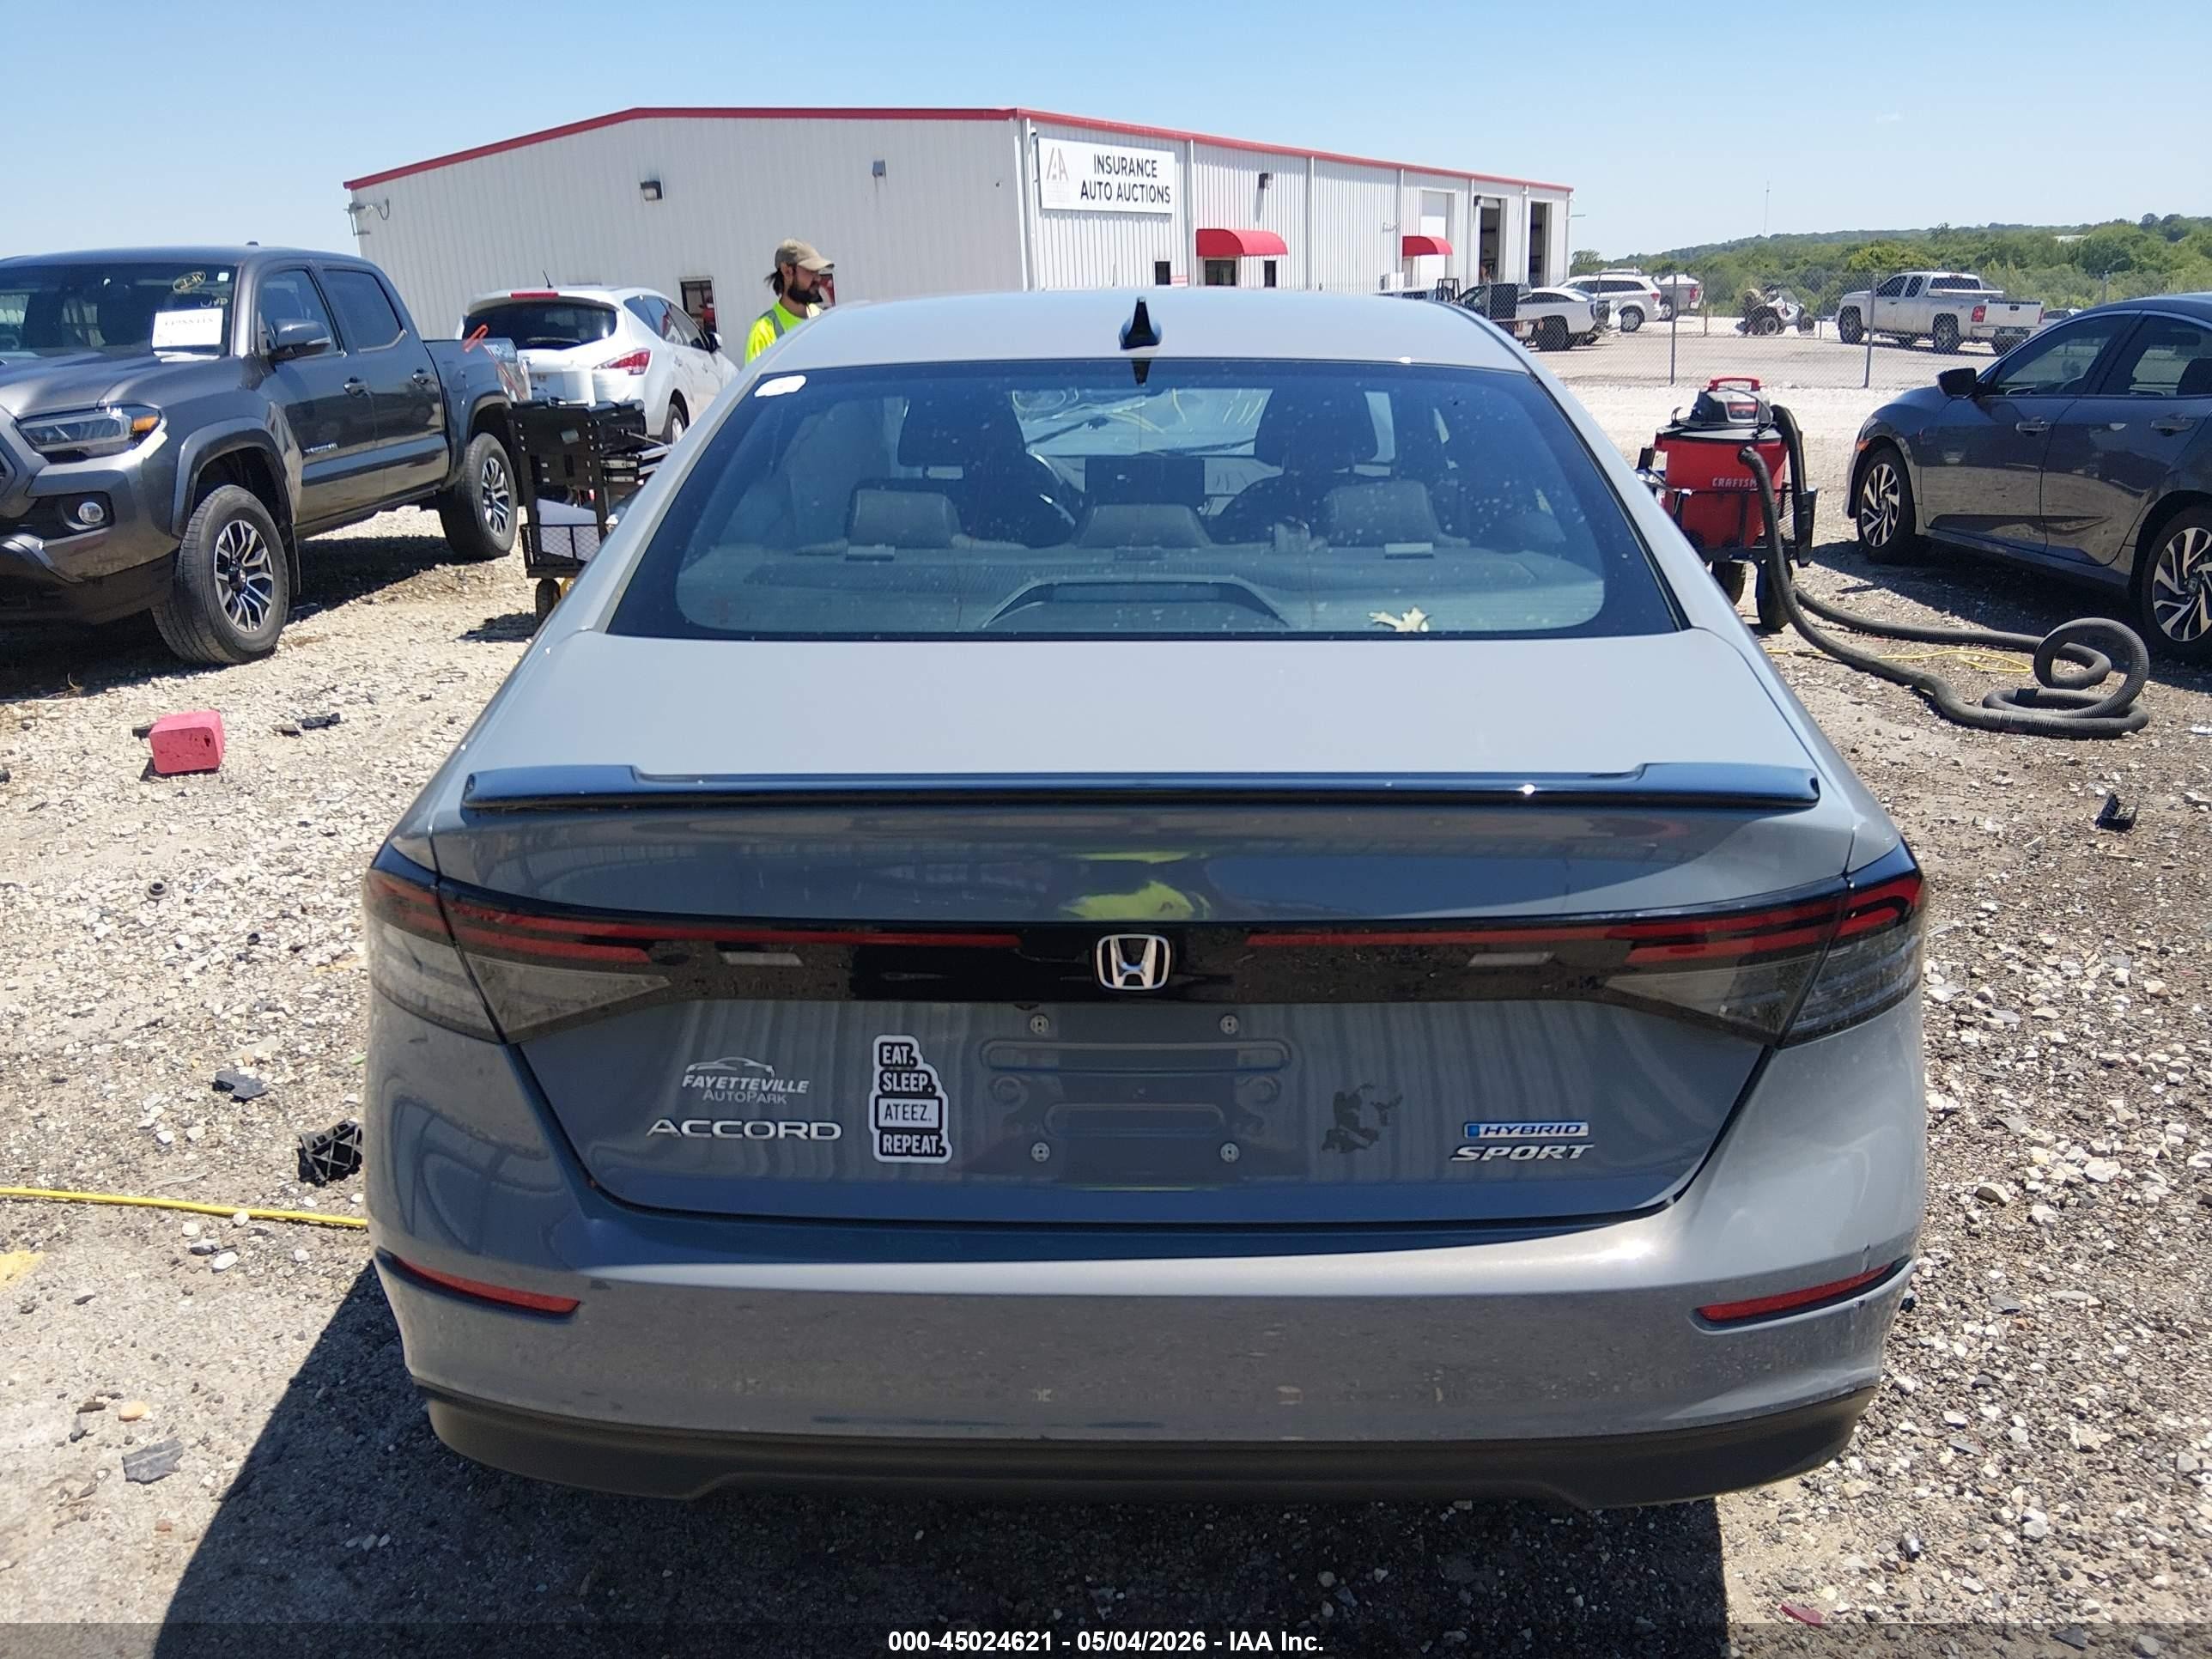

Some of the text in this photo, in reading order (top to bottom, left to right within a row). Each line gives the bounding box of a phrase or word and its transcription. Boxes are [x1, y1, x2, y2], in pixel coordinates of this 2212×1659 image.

[1093, 153, 1158, 179] INSURANCE
[1080, 179, 1113, 202] AUTO
[1116, 183, 1171, 204] AUCTIONS
[1711, 477, 1758, 489] CRAFTSM
[882, 1044, 915, 1065] EAT.
[681, 1074, 810, 1094] FAYETTEVILLE
[882, 1071, 933, 1093] SLEEP.
[884, 1103, 933, 1122] ATEEZ.
[646, 1118, 843, 1141] ACCORD
[1483, 1124, 1582, 1136] HYBRID
[882, 1133, 944, 1155] REPEAT.
[1450, 1143, 1595, 1162] SPORT
